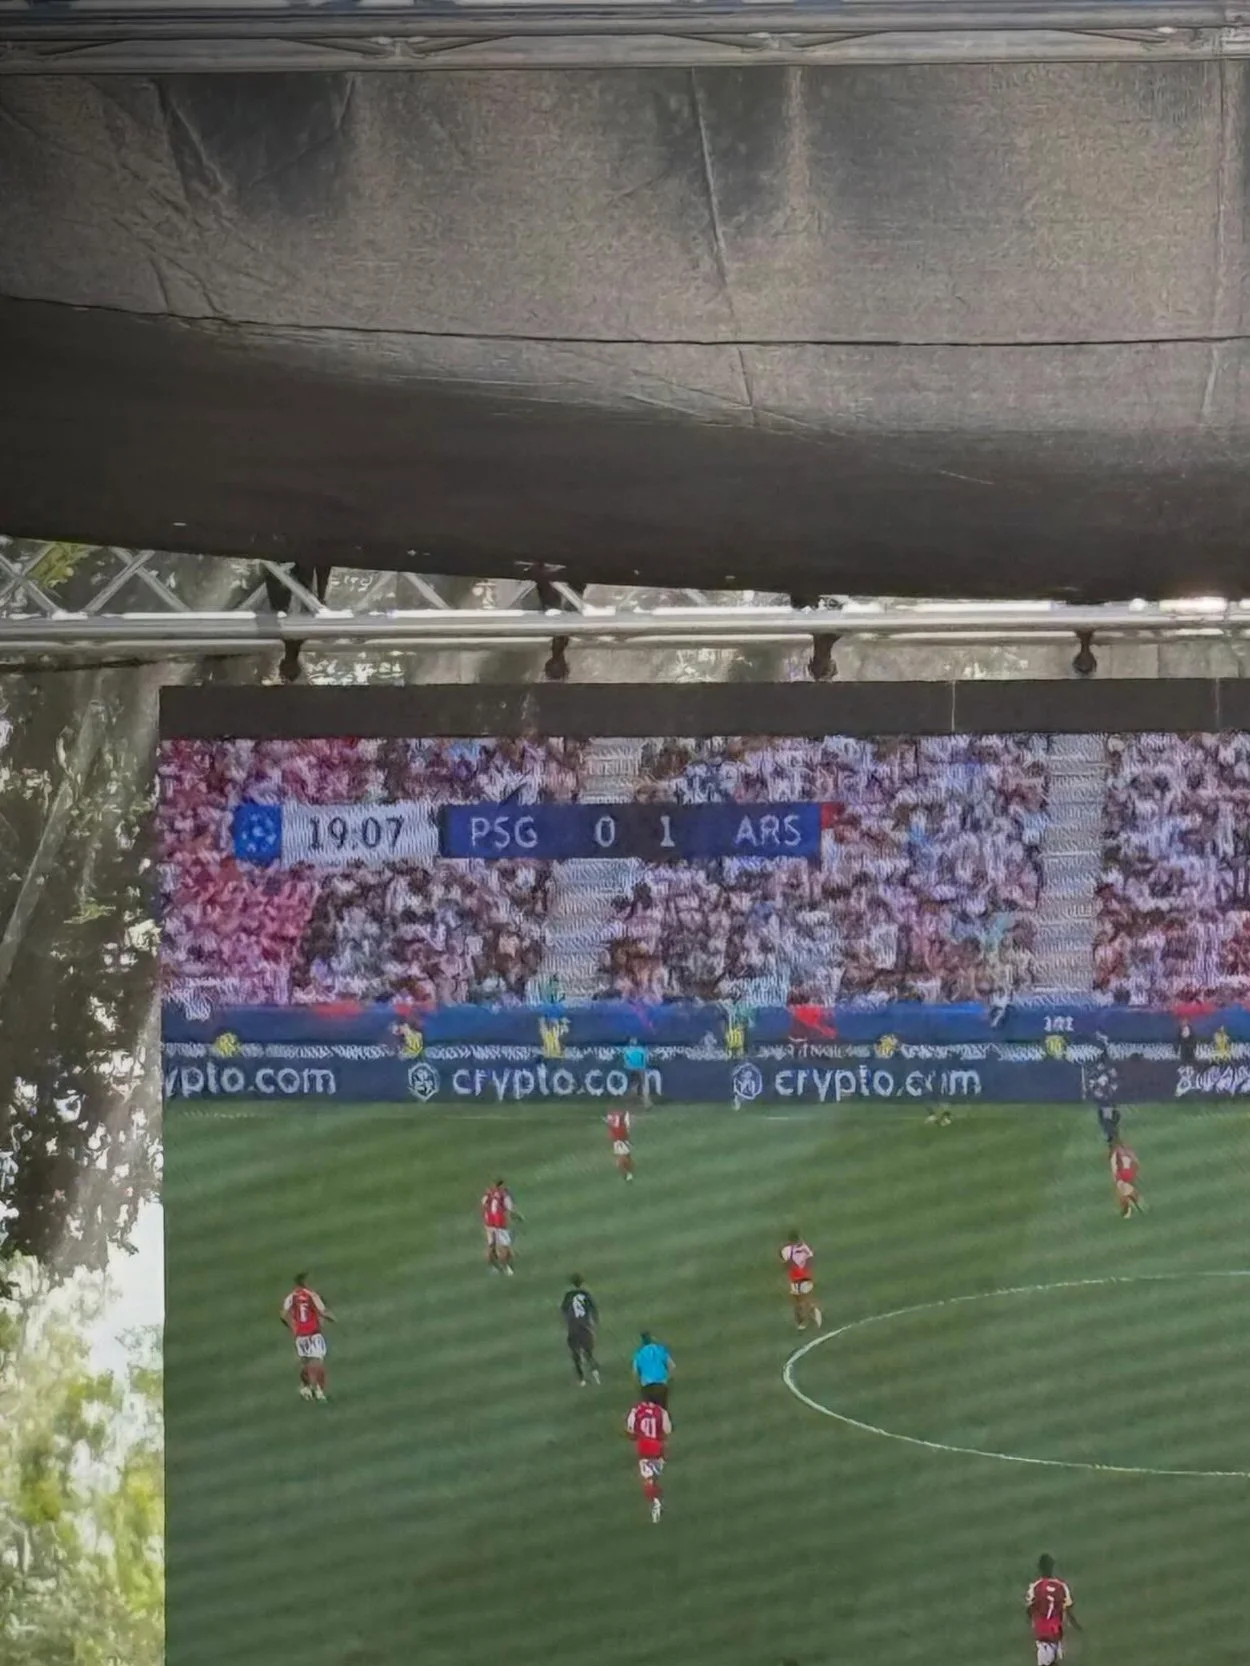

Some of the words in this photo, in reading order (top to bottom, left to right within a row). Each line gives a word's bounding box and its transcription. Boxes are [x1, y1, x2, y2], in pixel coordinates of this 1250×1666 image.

[308, 814, 403, 850] 19:07
[470, 815, 538, 849] PSG
[594, 816, 616, 848] 0
[659, 817, 676, 848] 1
[734, 814, 802, 848] ARS
